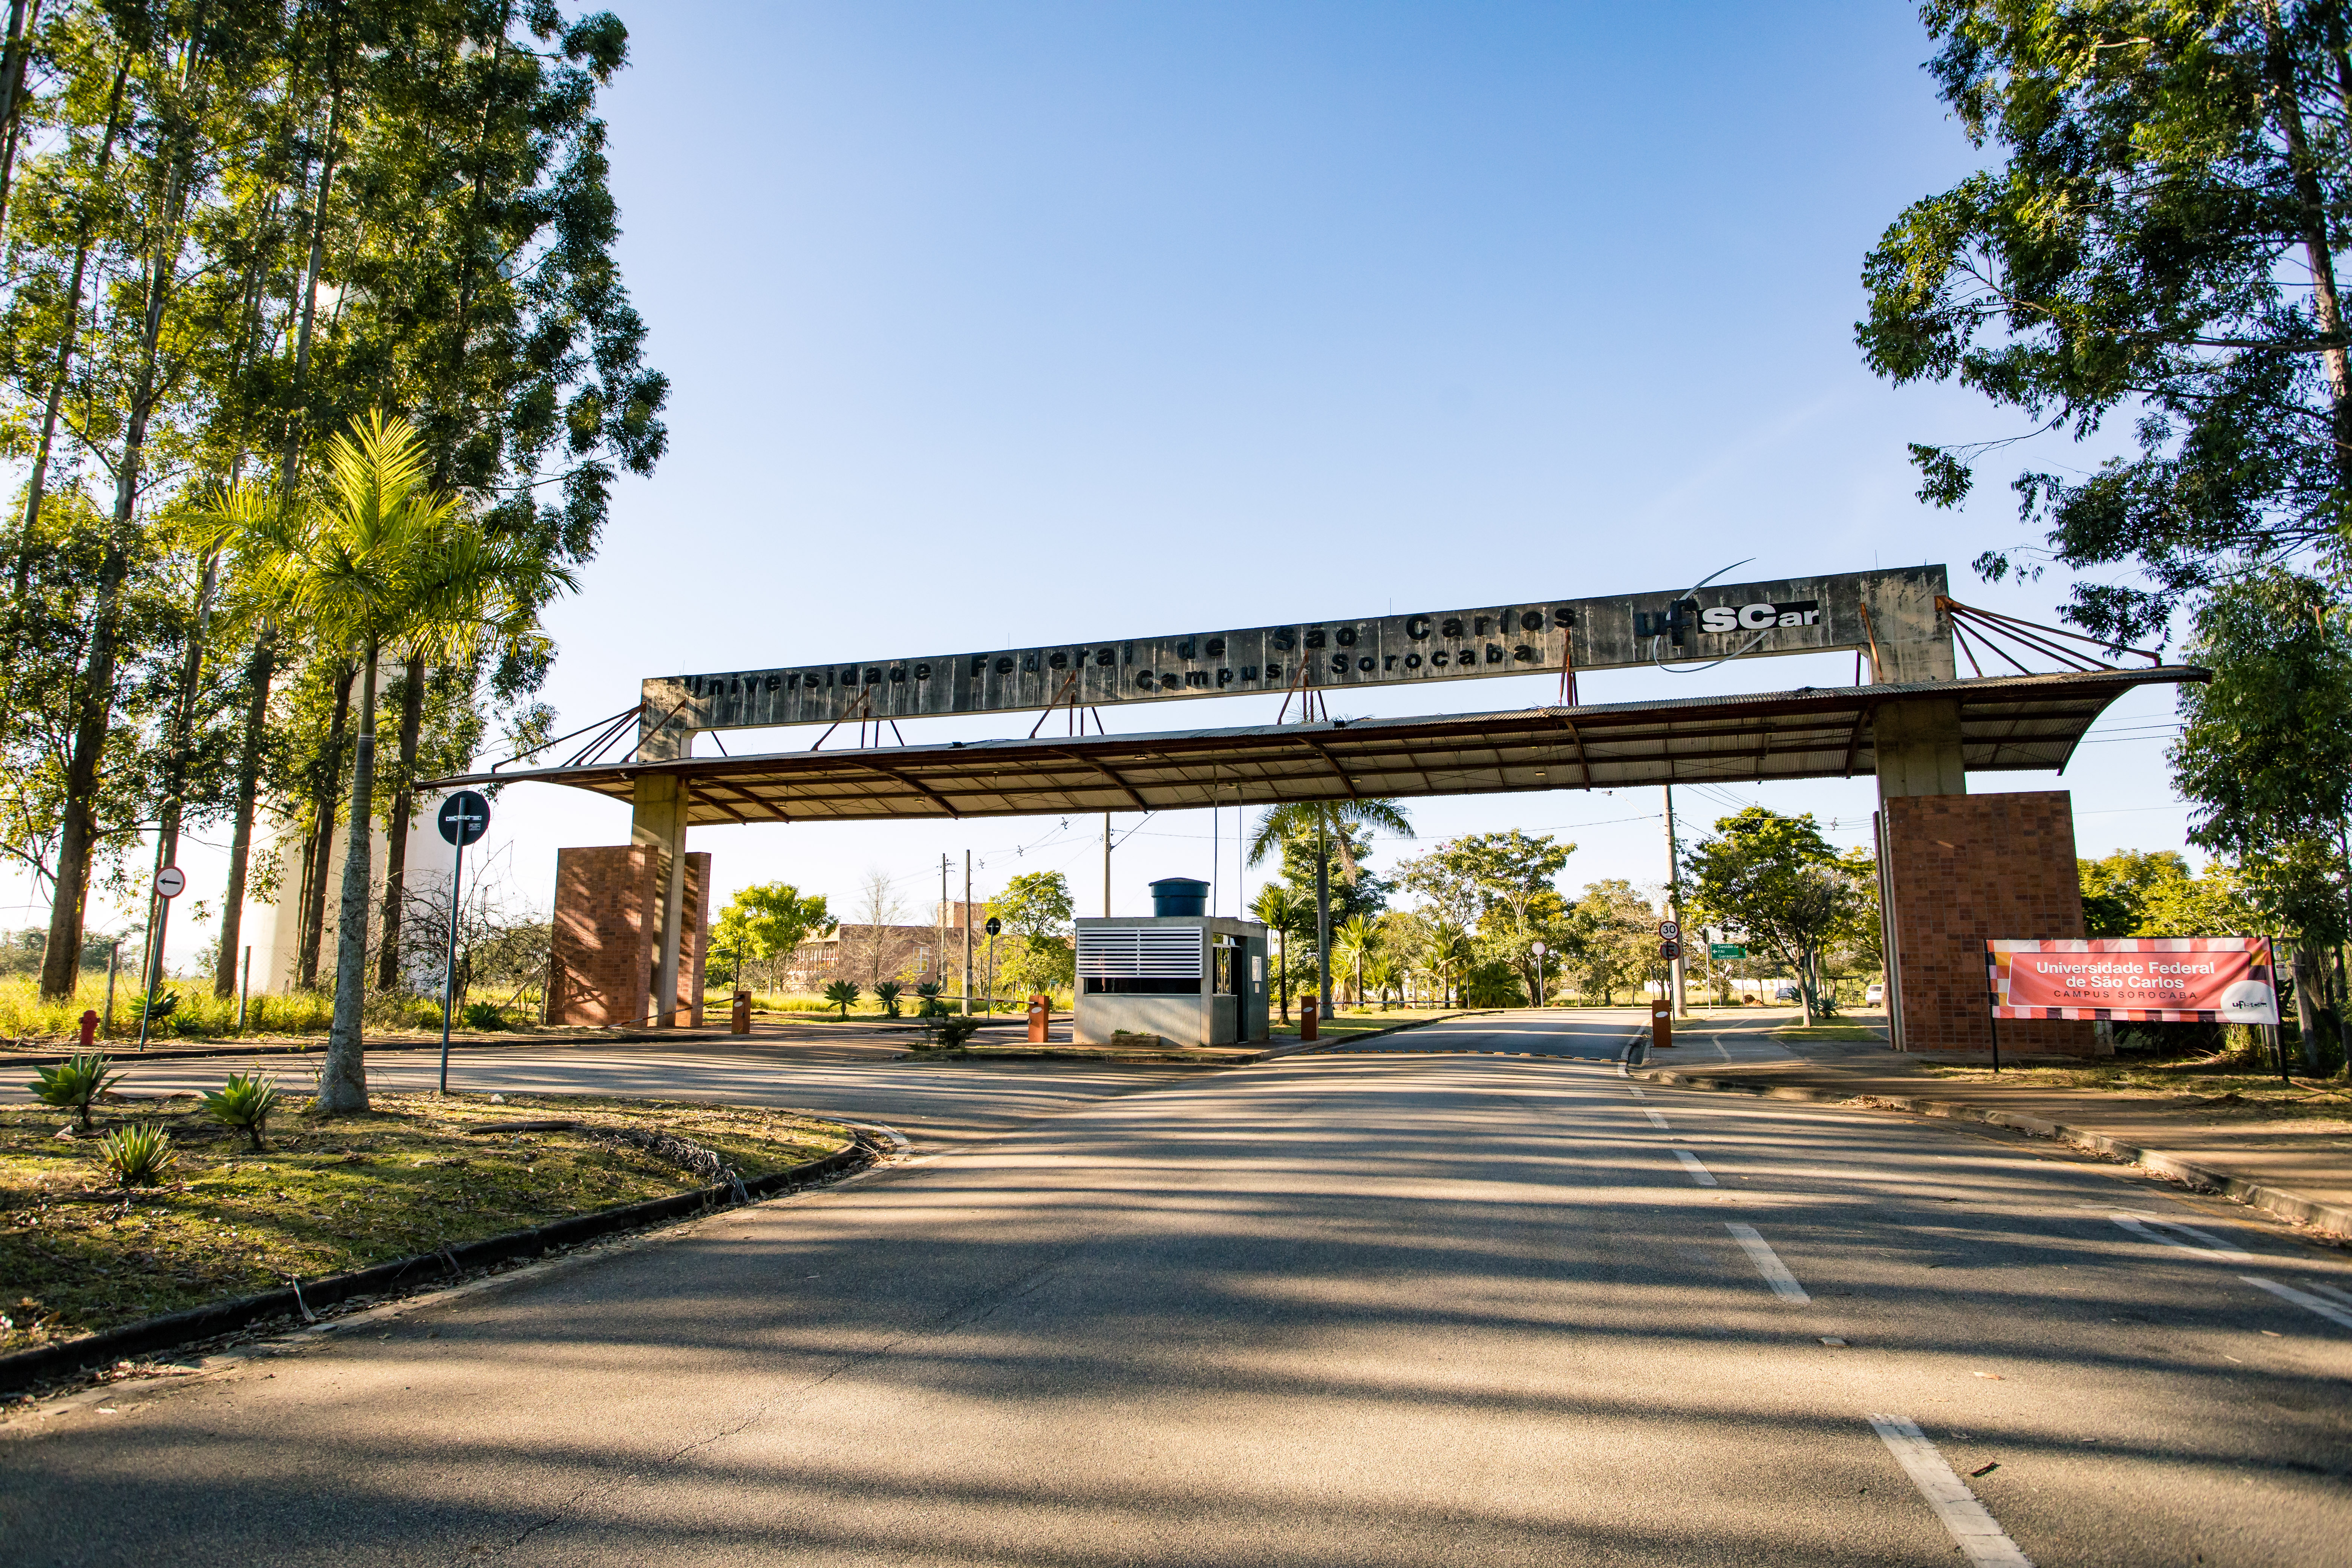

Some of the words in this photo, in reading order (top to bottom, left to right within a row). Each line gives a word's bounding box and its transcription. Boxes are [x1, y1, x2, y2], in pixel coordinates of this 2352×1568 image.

[684, 660, 932, 697] Universidade
[971, 640, 1132, 677] Federal
[1177, 635, 1226, 660] de
[1272, 622, 1357, 652] São
[1406, 608, 1576, 641] Carlos
[1136, 663, 1281, 690] Campus
[1331, 643, 1532, 675] Sorocaba
[1663, 925, 1676, 934] 30
[2036, 962, 2144, 974] Universidade
[2148, 962, 2215, 974] Federal
[2066, 975, 2086, 988] de
[2090, 975, 2123, 988] São
[2127, 975, 2185, 989] Carlos
